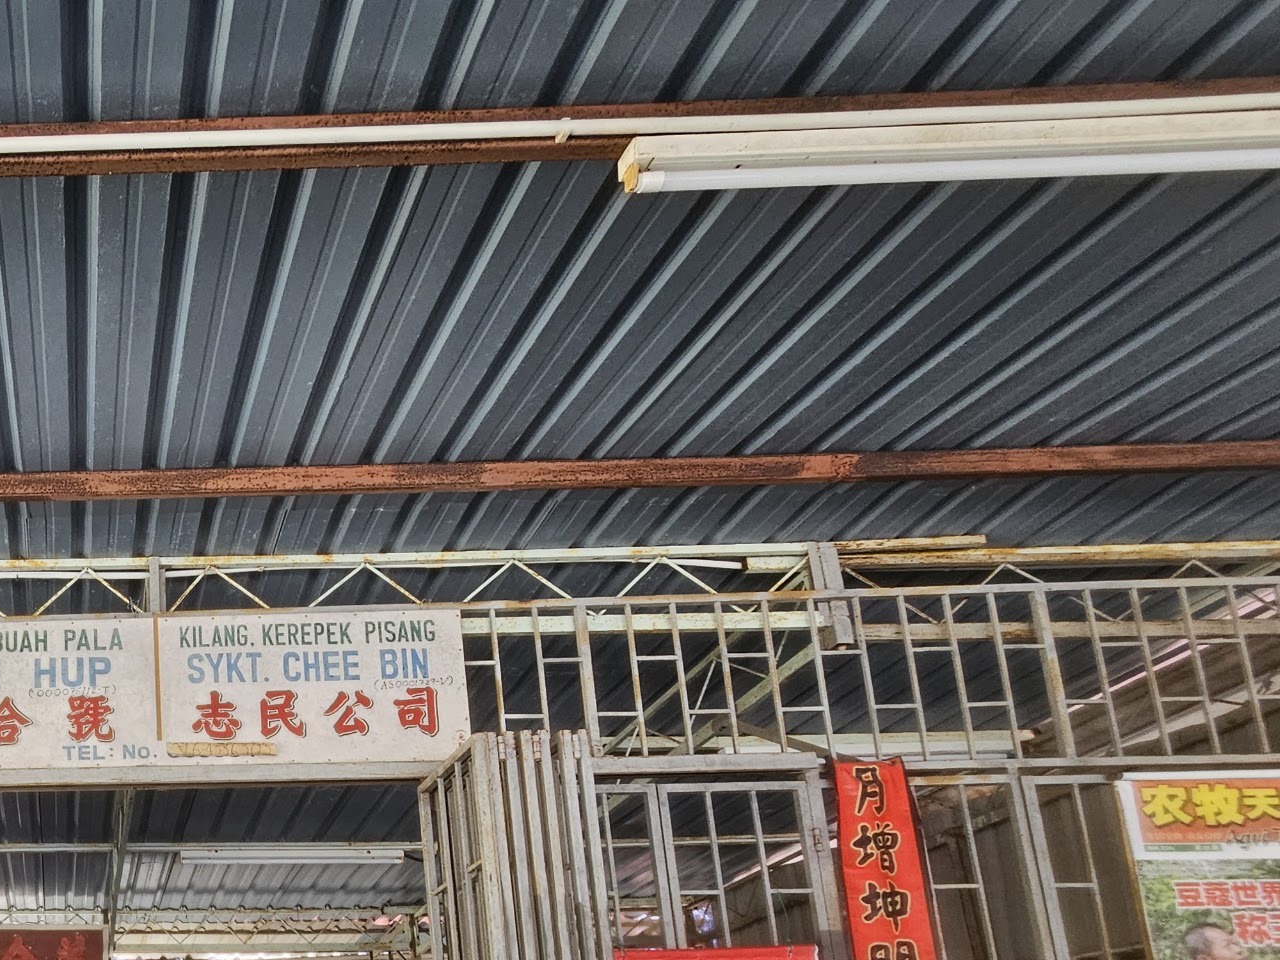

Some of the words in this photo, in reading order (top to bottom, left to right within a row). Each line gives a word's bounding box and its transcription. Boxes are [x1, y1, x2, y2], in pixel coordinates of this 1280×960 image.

[65, 628, 123, 651] PALA
[262, 621, 353, 646] KEREPEK
[365, 619, 436, 643] PISANG
[34, 656, 112, 688] HUP
[187, 651, 270, 683] SYKT.
[283, 650, 361, 682] CHEE
[379, 648, 430, 680] BIN
[191, 686, 440, 741] 志民公司
[62, 745, 114, 761] TEL:
